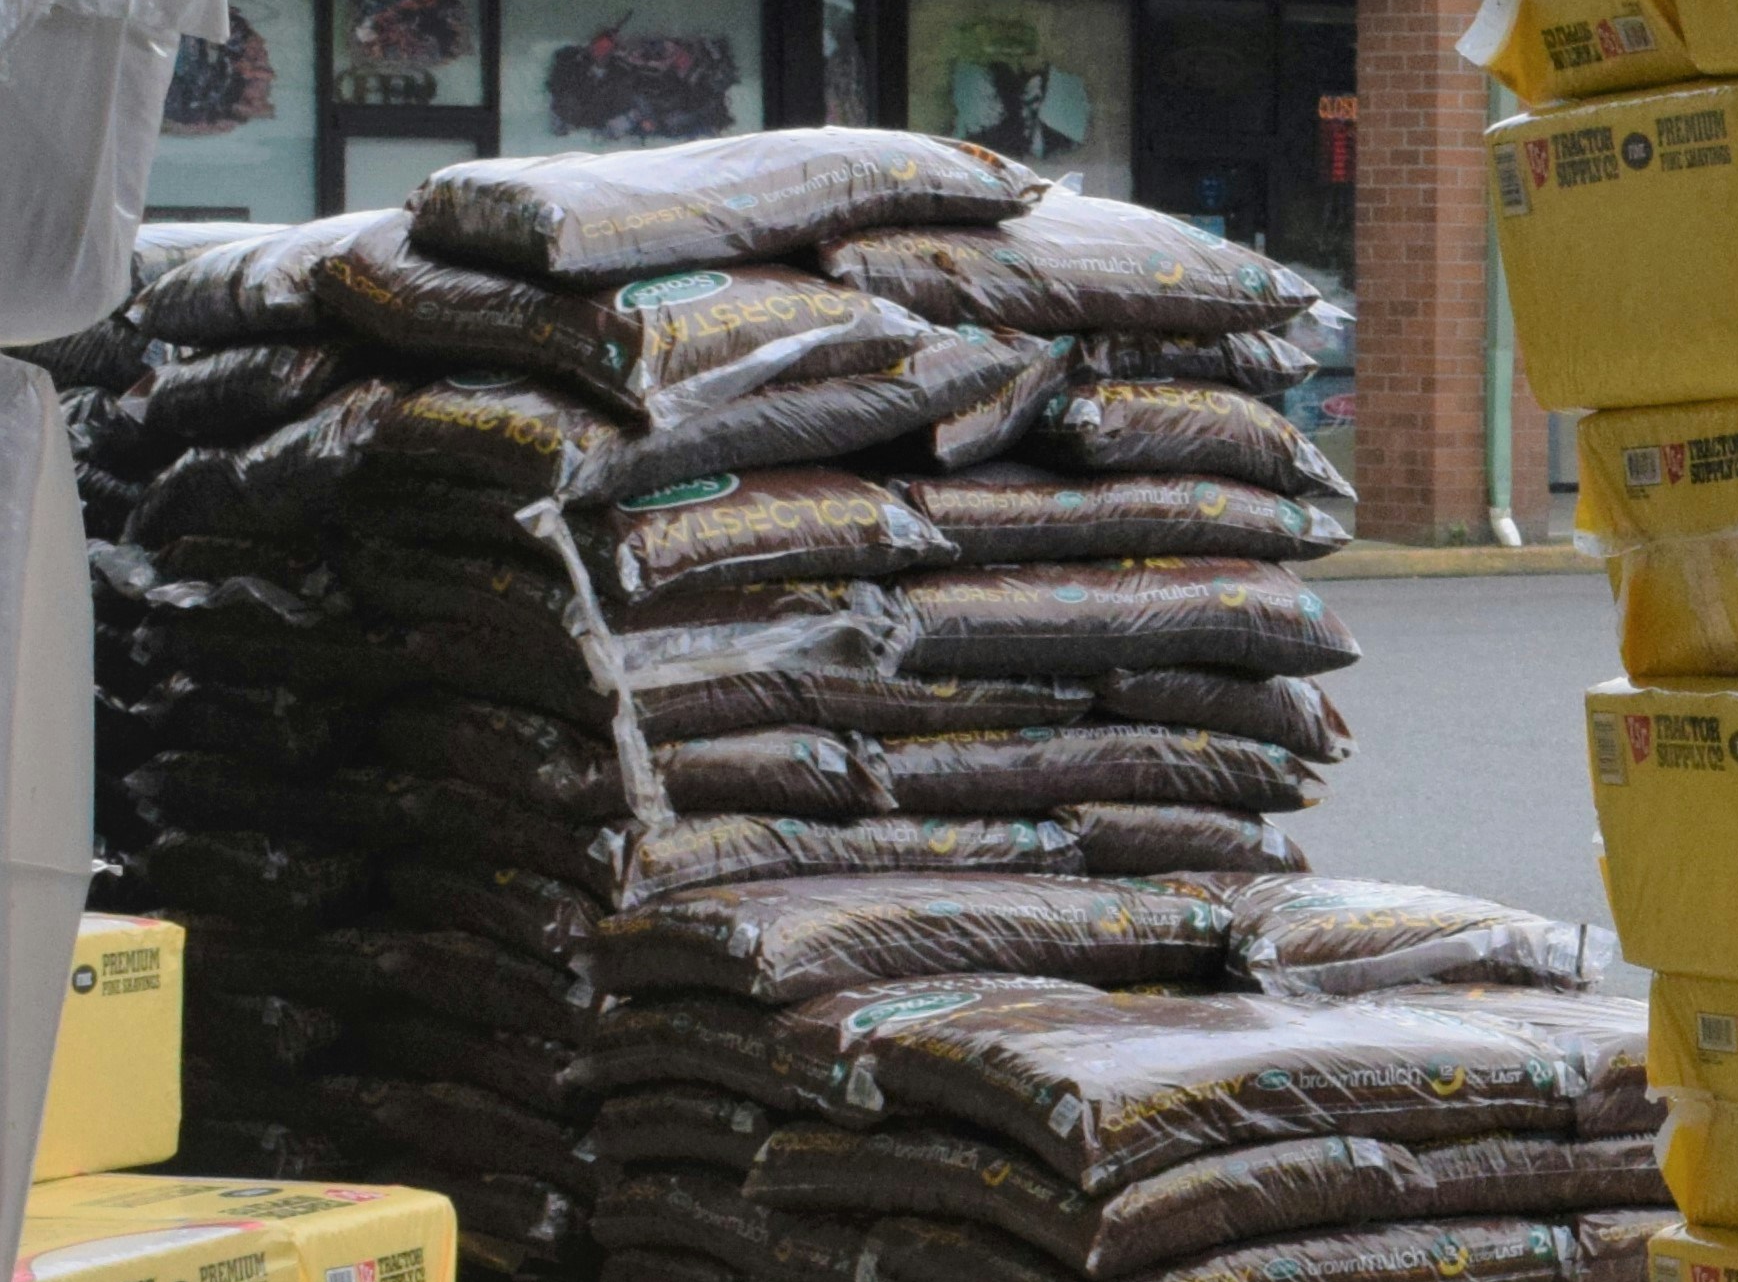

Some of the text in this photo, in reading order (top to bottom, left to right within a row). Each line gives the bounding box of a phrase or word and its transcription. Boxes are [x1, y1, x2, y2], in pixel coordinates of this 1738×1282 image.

[1657, 110, 1728, 146] PREMIUM
[1552, 127, 1612, 156] TRACTOR
[763, 163, 878, 203] brownmulch
[645, 499, 877, 549] COLORSTAY
[1094, 583, 1208, 605] brownmulch
[1656, 716, 1720, 742] TRACTOR
[102, 948, 160, 974] PREMIUM
[1300, 1064, 1420, 1089] brownmulch
[378, 1248, 424, 1272] TRACTOR
